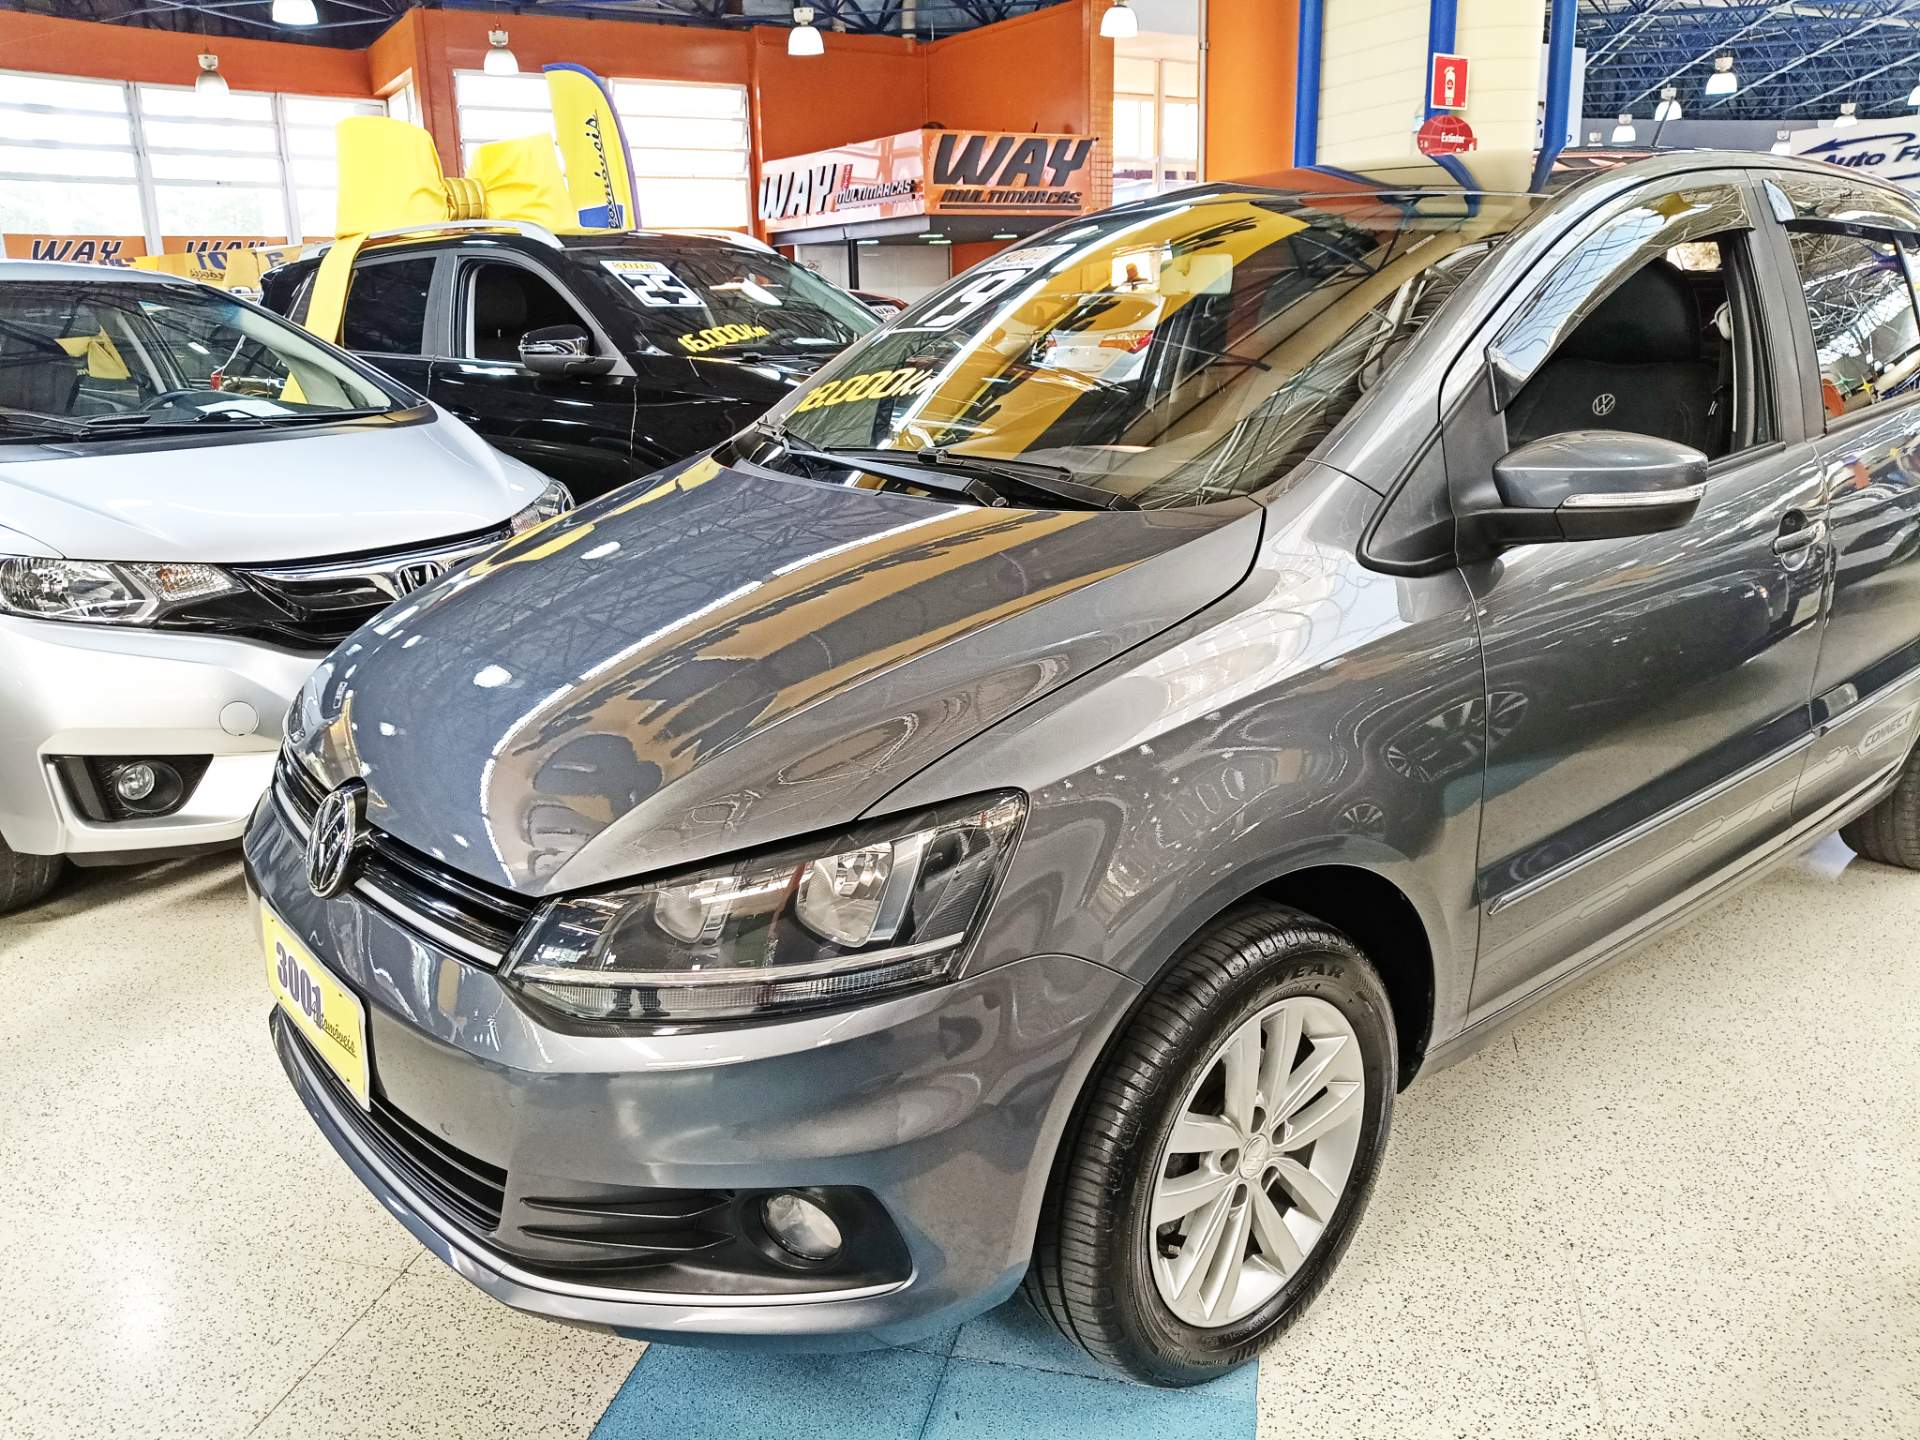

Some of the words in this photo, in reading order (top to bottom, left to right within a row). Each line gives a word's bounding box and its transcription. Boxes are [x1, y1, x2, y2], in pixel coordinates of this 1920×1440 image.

[932, 133, 1094, 187] WAY
[1823, 151, 1887, 168] Auto
[758, 163, 838, 219] WAY
[837, 178, 913, 205] MULTIMARCAS
[942, 188, 1083, 204] MULTIMARCAS
[32, 240, 123, 262] WAY
[619, 273, 702, 305] 25
[913, 268, 1028, 328] 19
[677, 322, 769, 353] 16.000Km
[275, 941, 322, 1018] 3001
